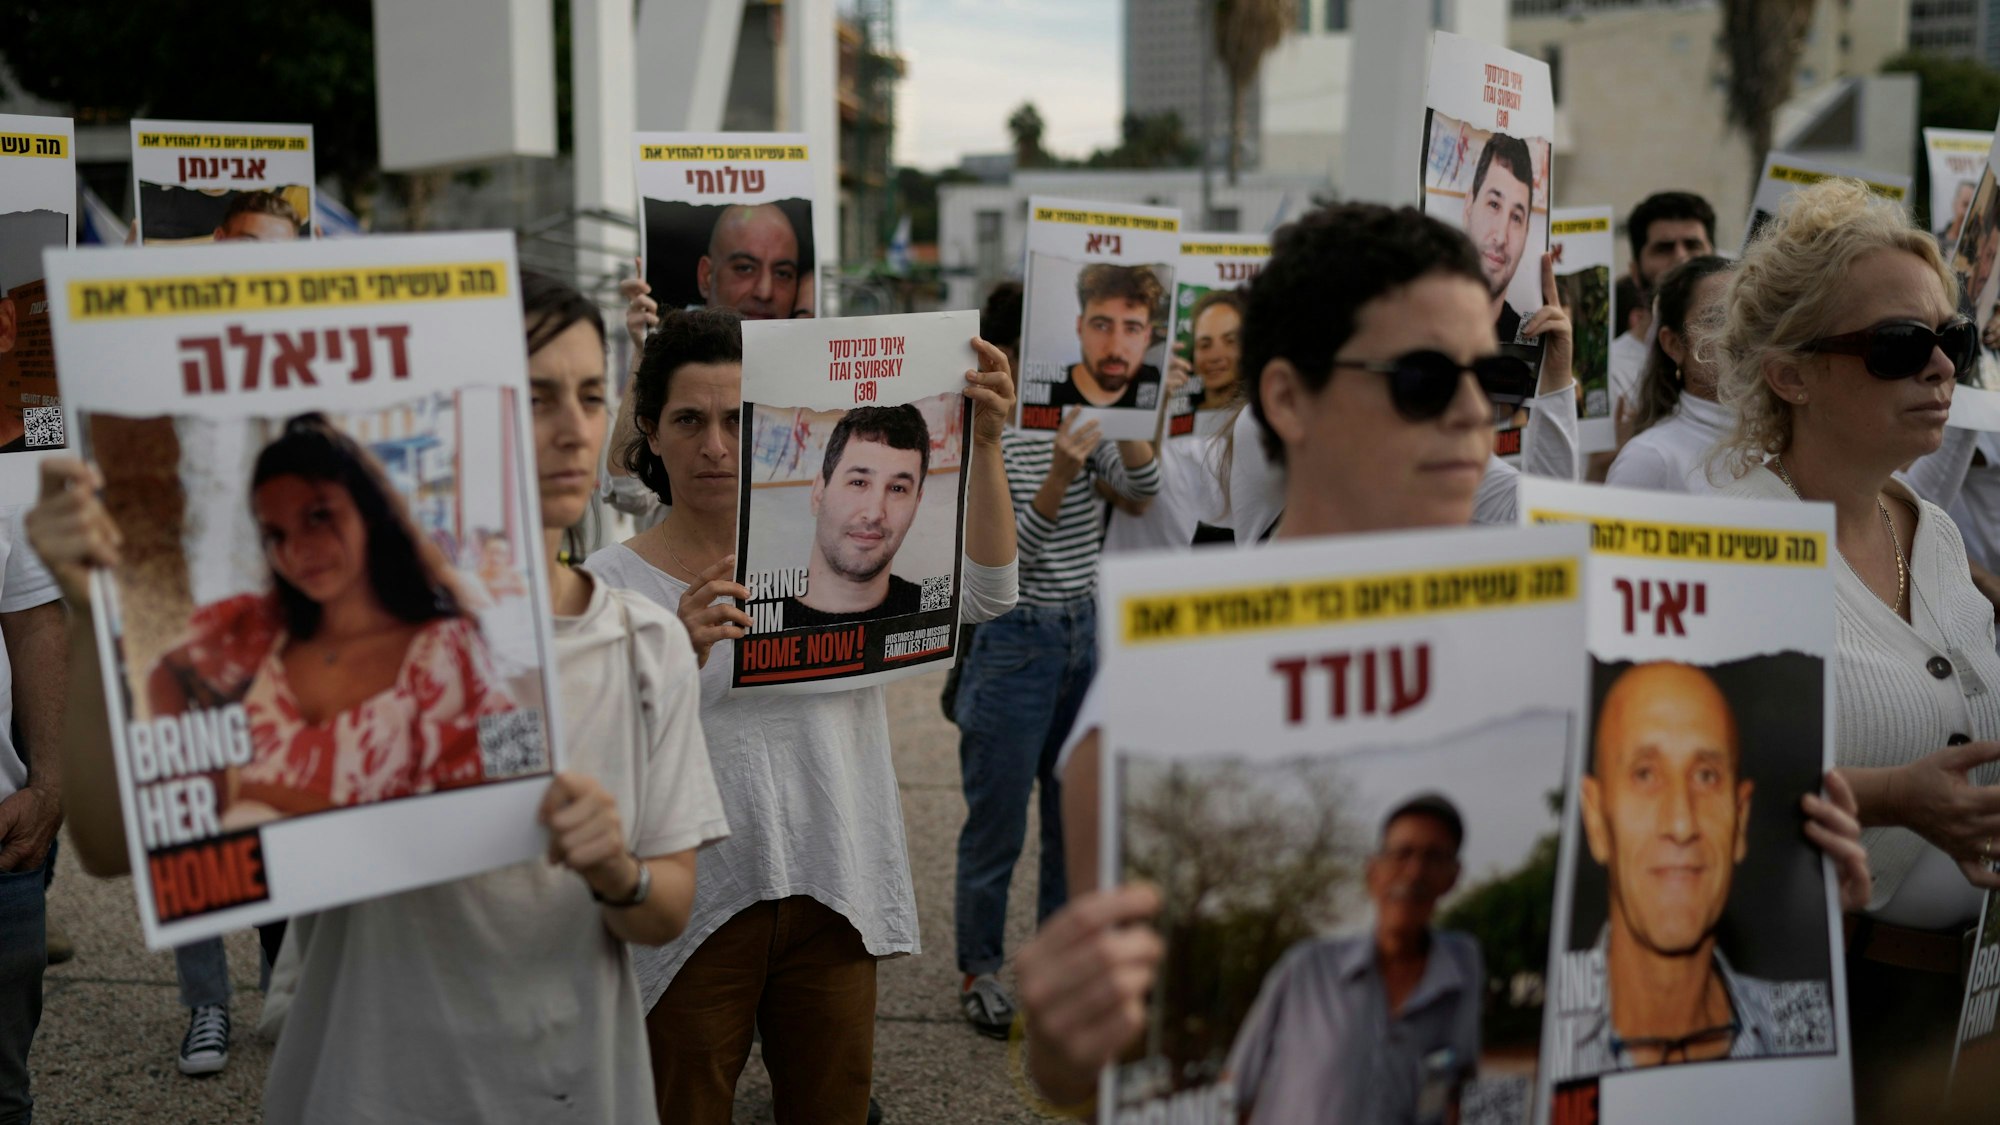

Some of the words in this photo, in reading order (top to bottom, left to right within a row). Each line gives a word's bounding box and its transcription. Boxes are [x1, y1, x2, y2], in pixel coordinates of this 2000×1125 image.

[1483, 85, 1496, 104] ITAI
[1497, 88, 1521, 111] SVIRSKY
[36, 138, 61, 155] מה
[142, 134, 159, 147] את
[164, 134, 200, 147] להחזיר
[204, 136, 221, 148] כדי
[225, 137, 248, 148] היום
[289, 138, 304, 149] מה
[645, 148, 662, 159] את
[665, 146, 704, 159] להחזיר
[707, 148, 724, 159] כדי
[728, 148, 751, 159] היום
[178, 157, 266, 183] אבינתן
[686, 166, 765, 194] שלומי
[1085, 232, 1121, 255] גיא
[139, 277, 238, 312] להחזיר
[247, 278, 290, 305] כדי
[299, 275, 358, 303] היום
[368, 271, 450, 299] עשיתי
[459, 269, 496, 294] מה
[82, 287, 127, 315] את
[829, 338, 877, 361] סבירסקי
[880, 336, 905, 356] איתי
[178, 325, 410, 395] דניאלה
[829, 362, 851, 381] ITAI
[855, 358, 903, 379] SVIRSKY
[1633, 525, 1660, 552] כדי
[1667, 530, 1711, 556] היום
[1719, 533, 1779, 560] עשינו
[1785, 536, 1817, 562] מה
[746, 567, 808, 603] BRING
[1528, 566, 1566, 598] מה
[1194, 585, 1292, 630] להחזיר
[1301, 585, 1344, 620] כדי
[1354, 579, 1413, 614] היום
[1613, 577, 1706, 636] יאיר
[745, 601, 784, 635] HIM
[1133, 599, 1184, 636] את
[884, 639, 920, 658] FAMILIES
[922, 634, 949, 652] FORUM
[885, 631, 914, 644] HOSTAGES
[914, 628, 926, 639] AND
[927, 624, 951, 637] MISSING
[743, 636, 802, 671] HOME
[807, 625, 865, 664] NOW!
[1271, 643, 1433, 725] עודד
[129, 704, 252, 784] BRING
[139, 777, 217, 848] HER
[151, 835, 263, 921] HOME
